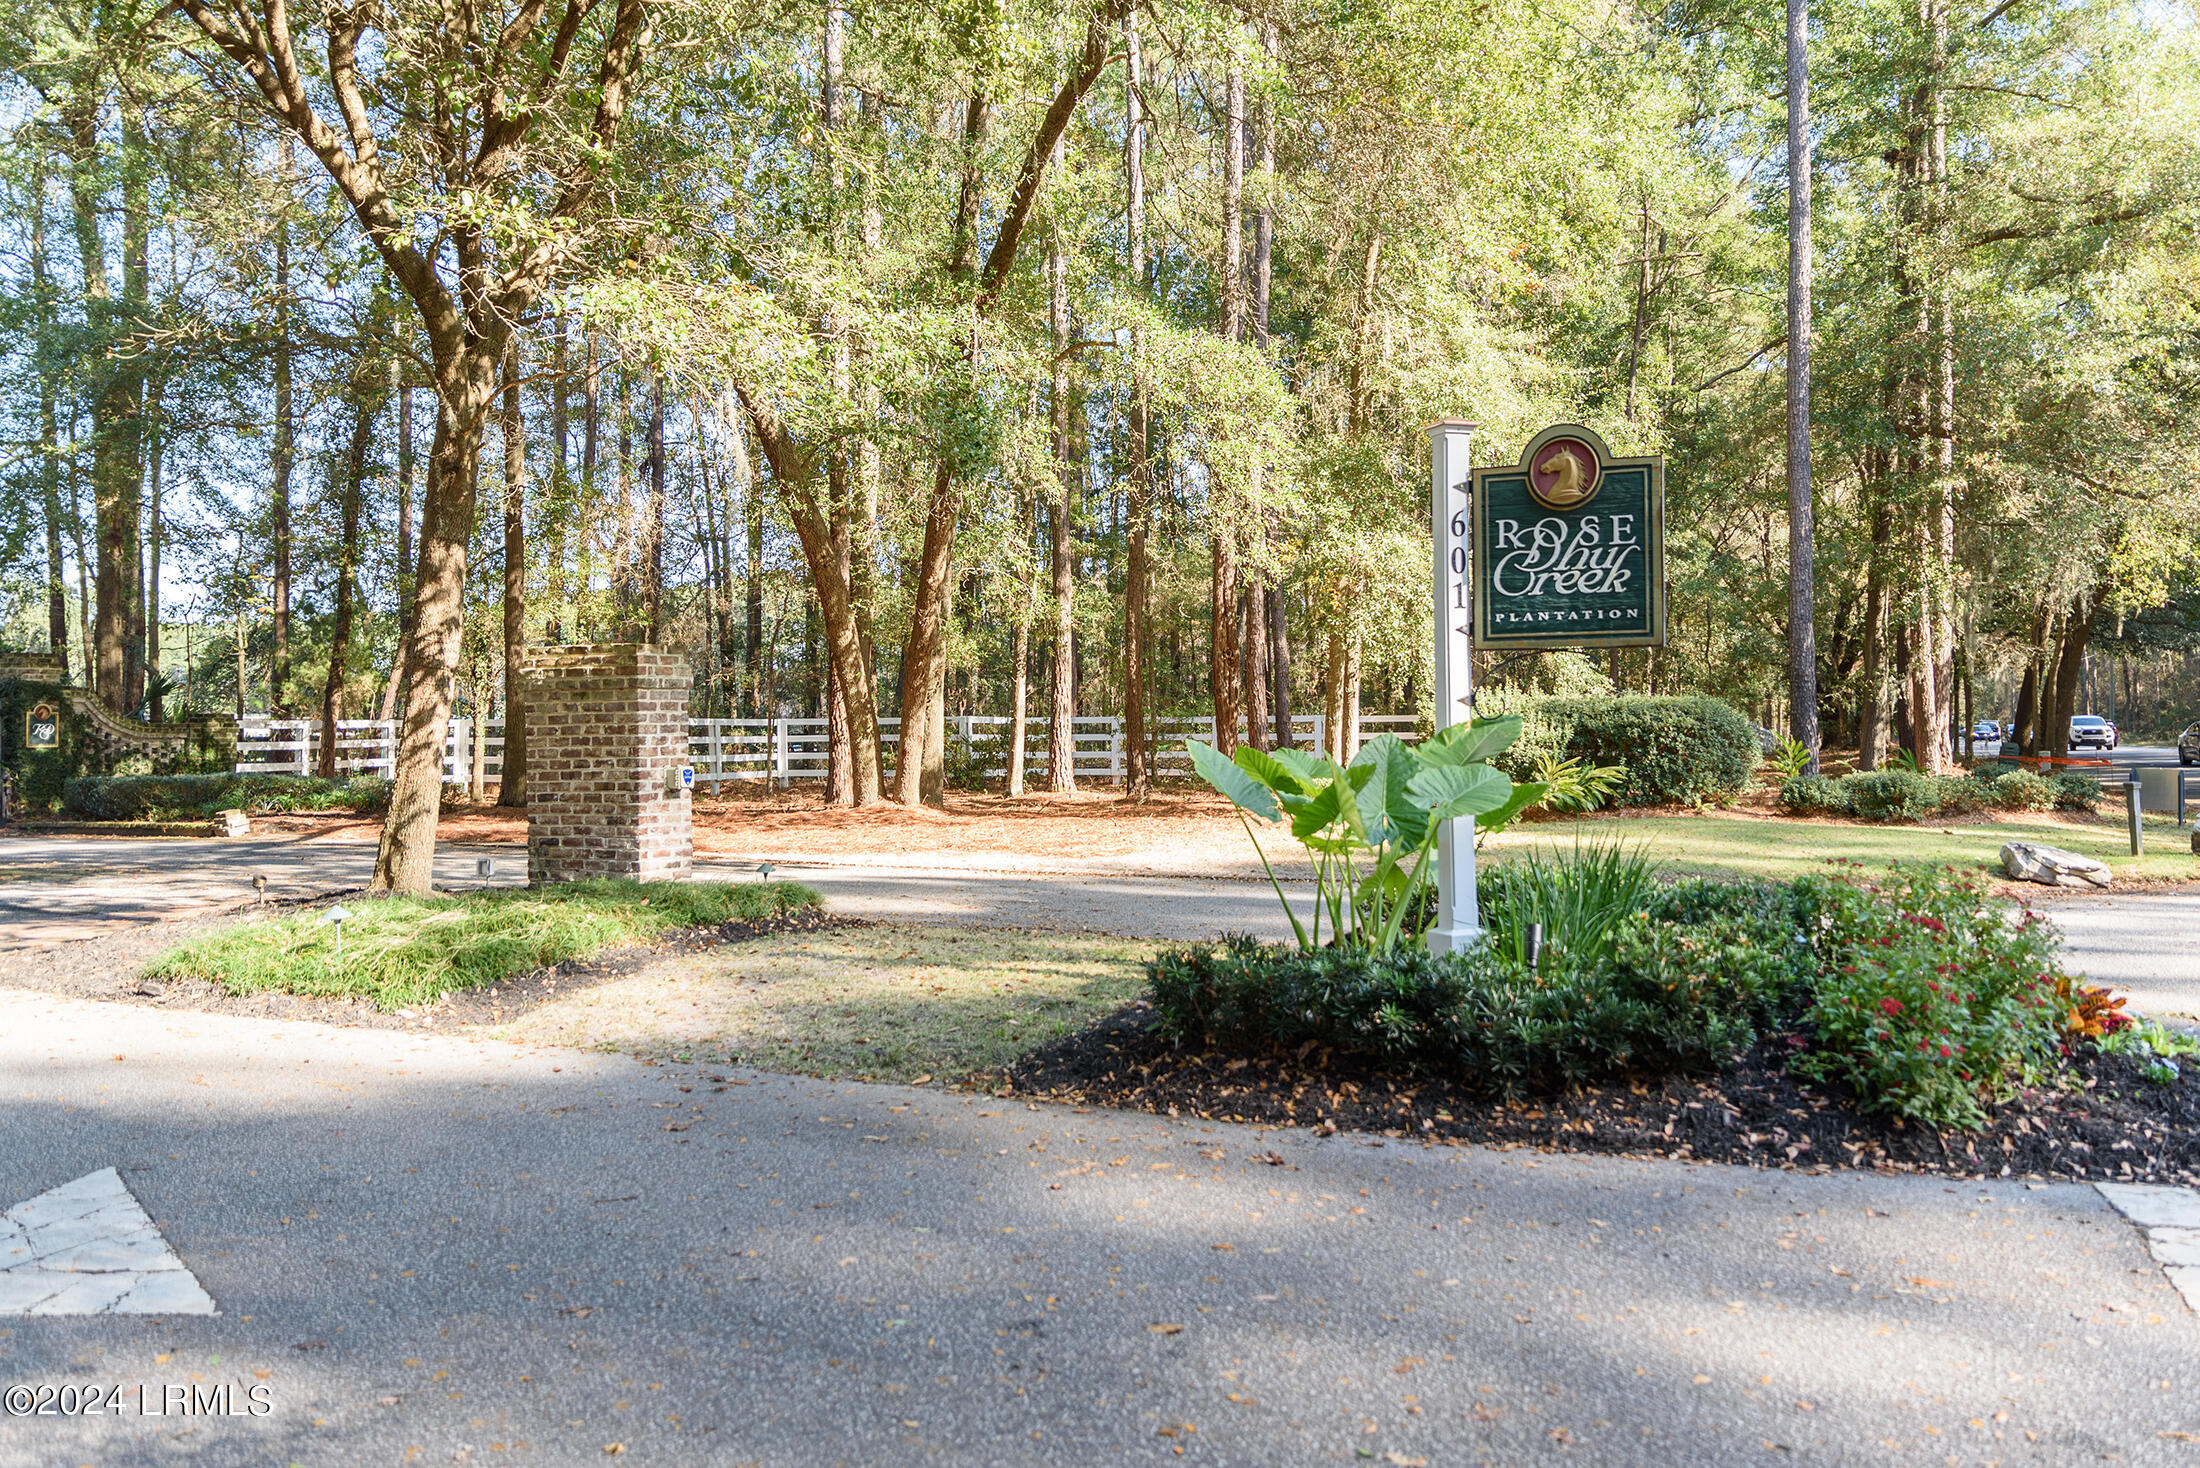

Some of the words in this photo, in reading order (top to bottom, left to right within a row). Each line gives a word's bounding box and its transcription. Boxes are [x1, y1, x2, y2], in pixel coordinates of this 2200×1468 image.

[1495, 514, 1637, 549] ROSE
[1513, 523, 1619, 572] Dhu
[1451, 509, 1466, 609] 601
[1493, 545, 1640, 597] Creek
[1495, 608, 1639, 622] PLANTATION
